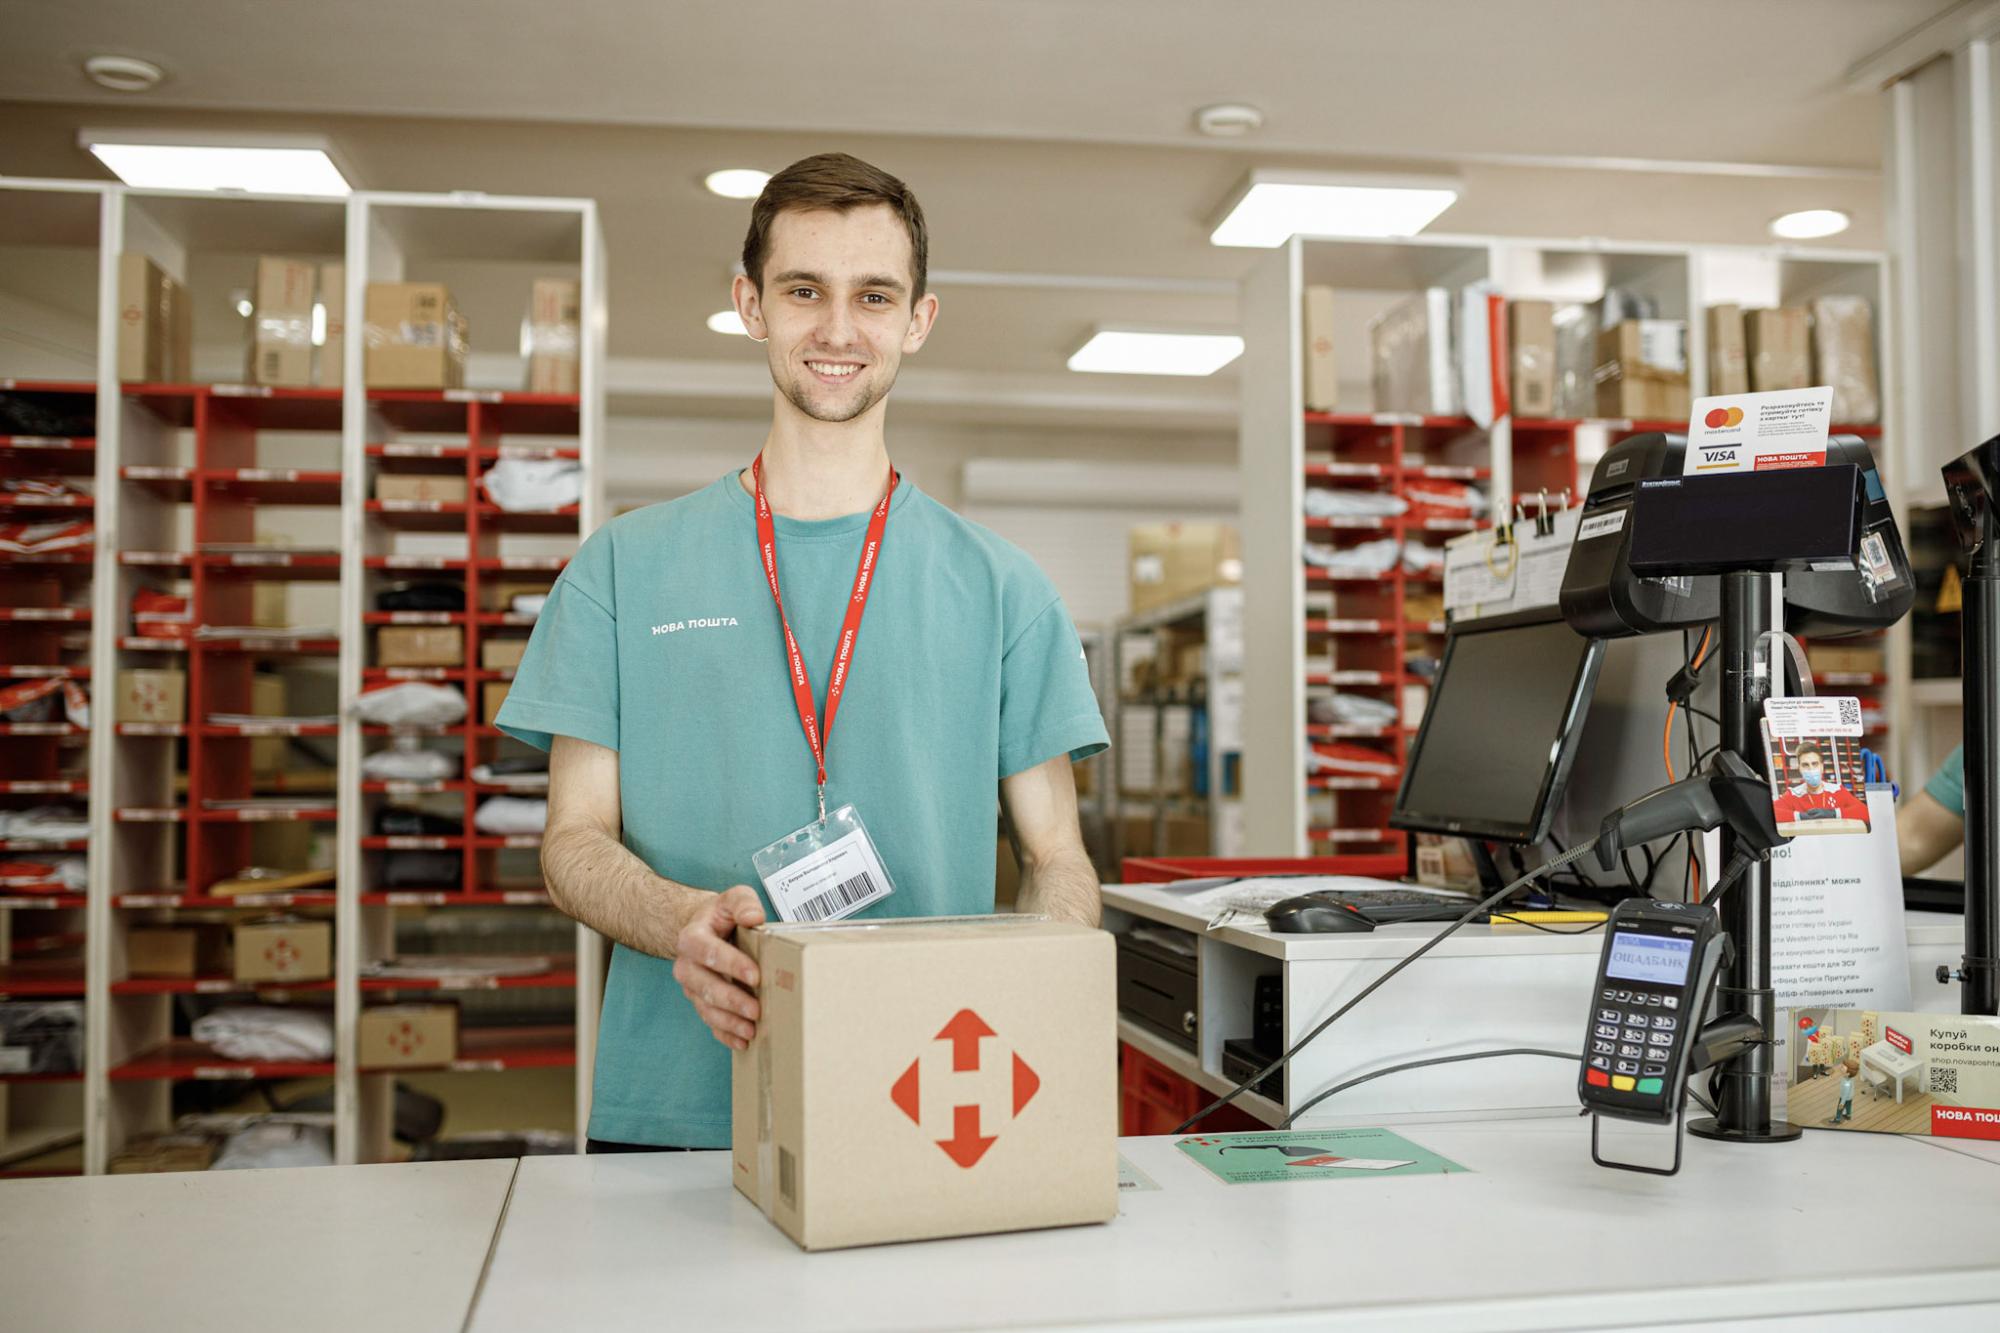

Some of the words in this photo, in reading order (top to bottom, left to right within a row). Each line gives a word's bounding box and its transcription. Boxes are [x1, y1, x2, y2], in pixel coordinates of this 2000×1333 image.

[1704, 428, 1741, 436] mastercard
[1705, 450, 1736, 463] VISA
[1757, 456, 1777, 464] НОВА
[857, 570, 869, 593] НОВА
[863, 541, 877, 570] ПОШТА
[651, 621, 685, 636] НОВА
[688, 617, 739, 629] ПОШТА
[834, 661, 846, 686] НОВА
[840, 629, 854, 660] ПОШТА
[793, 654, 805, 686] ПОШТА
[808, 725, 818, 750] НОВА
[1831, 877, 1861, 885] можна
[1930, 1028, 1968, 1039] Купуй
[1930, 1042, 1981, 1053] коробки
[1936, 1110, 1973, 1121] НОВА
